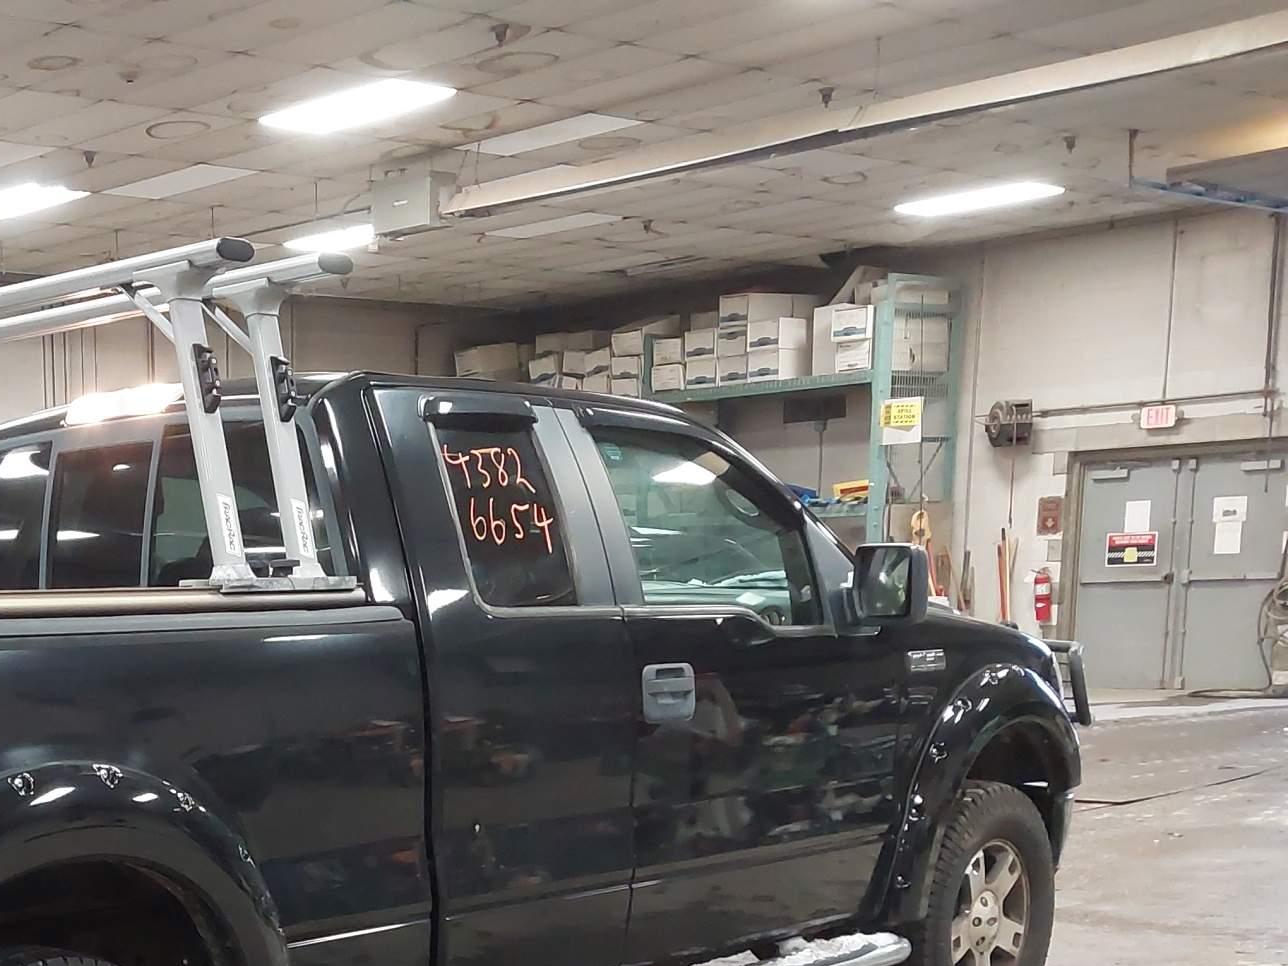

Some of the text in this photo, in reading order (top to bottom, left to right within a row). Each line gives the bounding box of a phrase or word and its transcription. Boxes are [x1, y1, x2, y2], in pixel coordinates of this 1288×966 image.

[1146, 407, 1171, 425] EXIT
[440, 444, 536, 493] 4382
[470, 497, 554, 554] 6654
